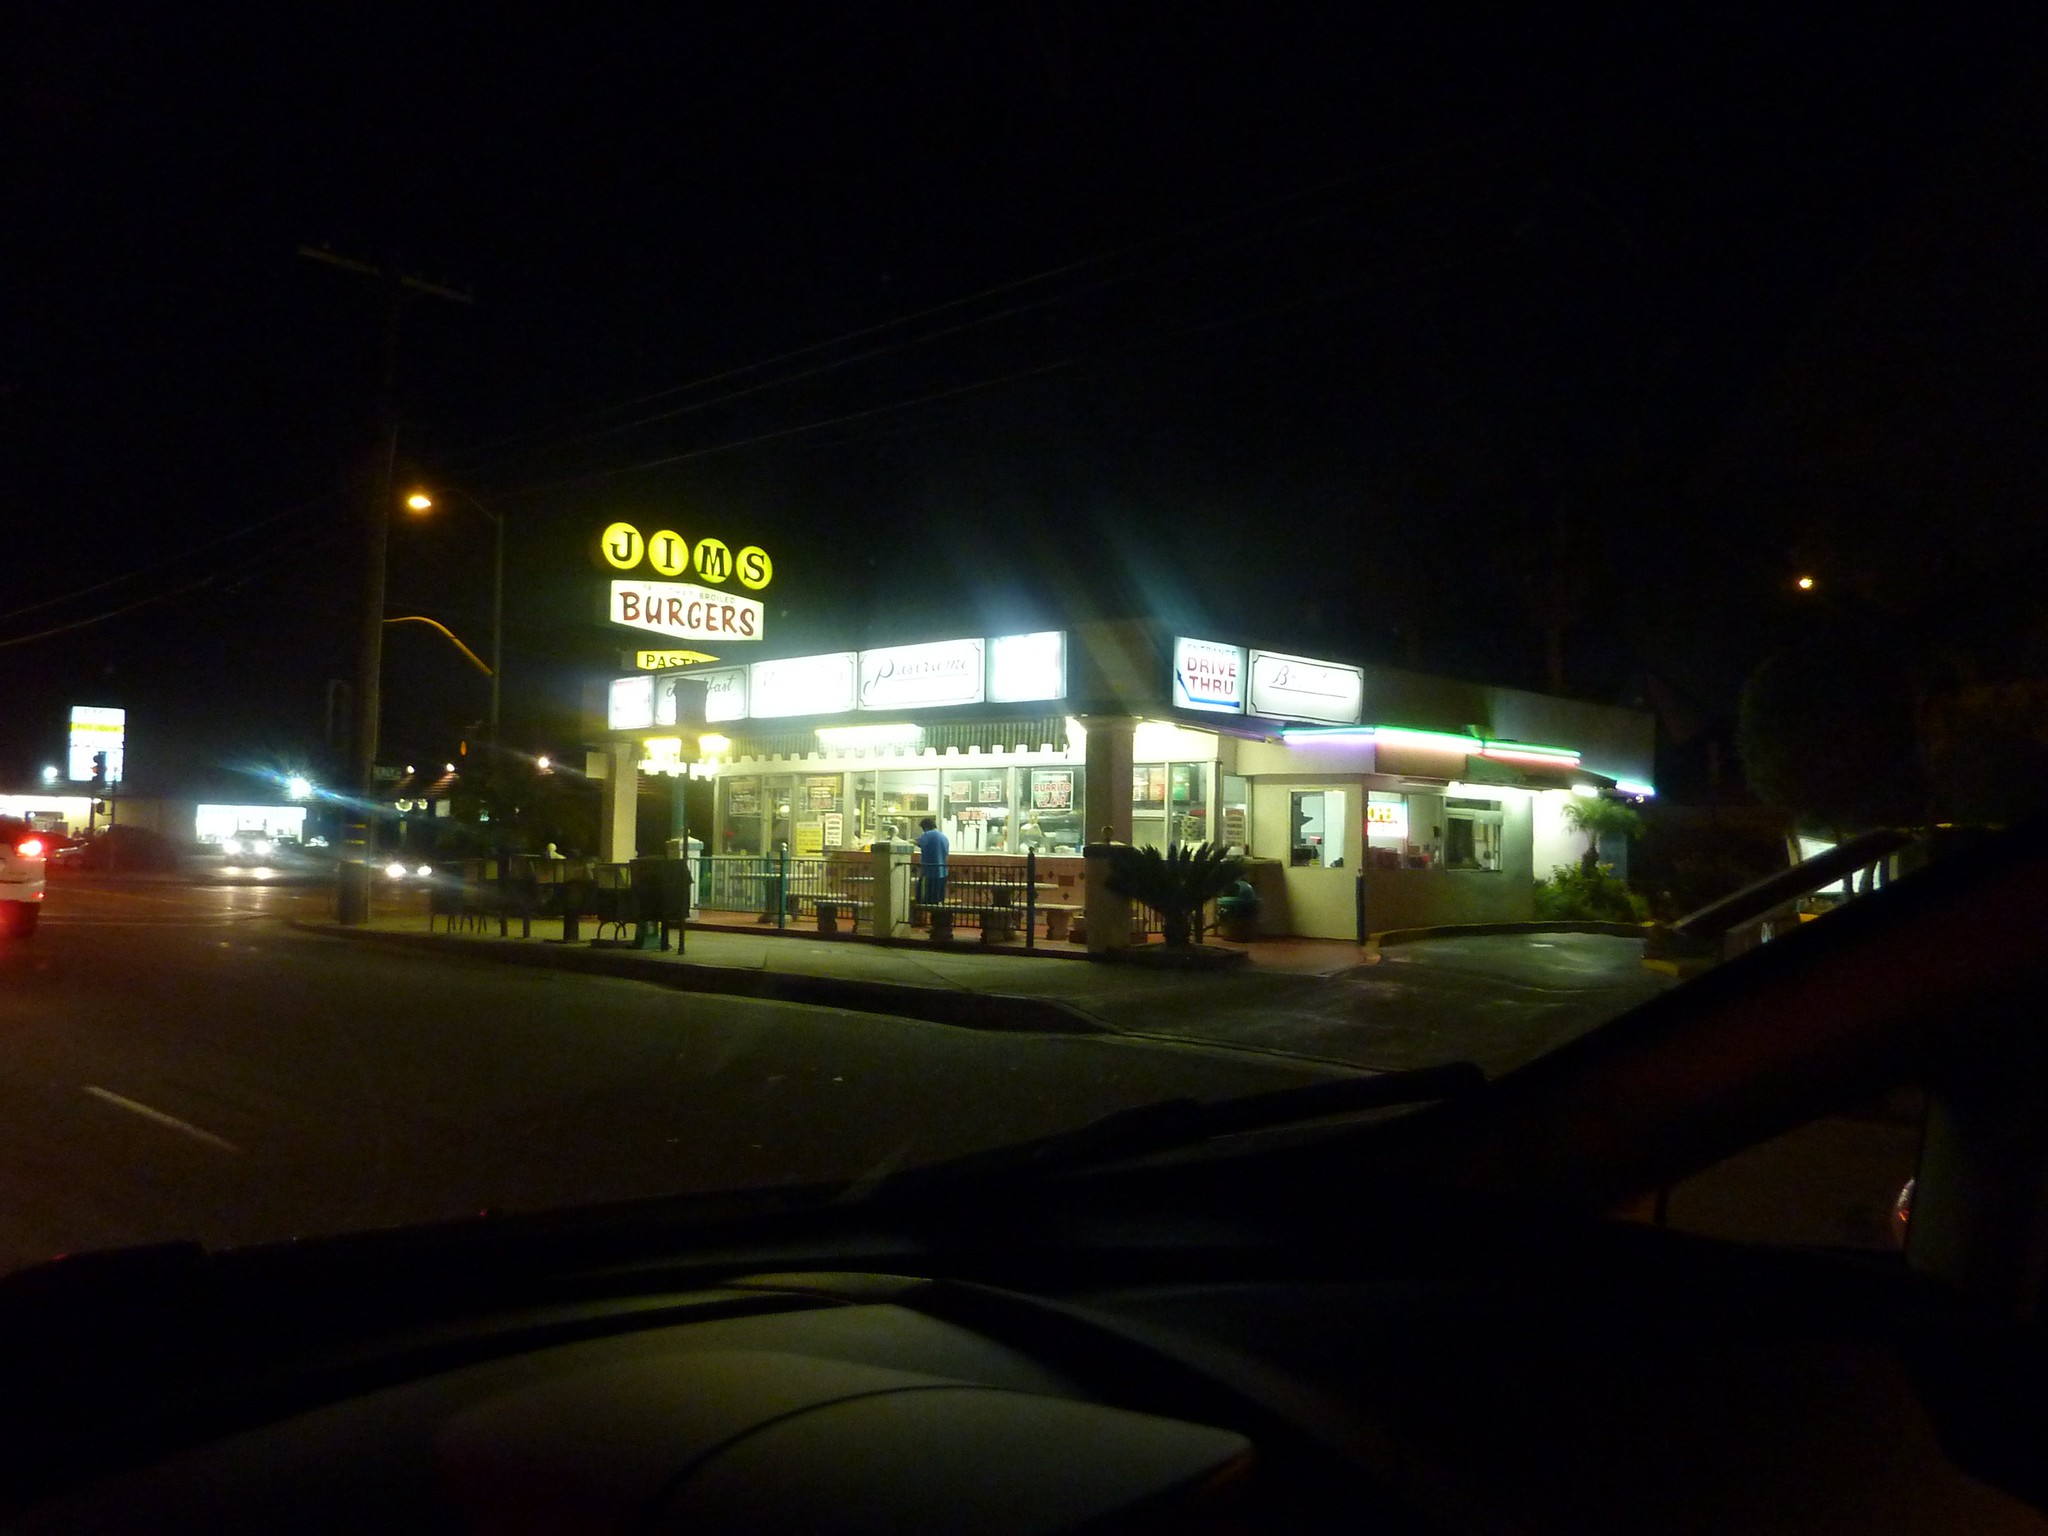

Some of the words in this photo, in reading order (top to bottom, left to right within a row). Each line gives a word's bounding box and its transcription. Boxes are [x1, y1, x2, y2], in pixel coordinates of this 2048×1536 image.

[610, 531, 765, 582] JIMS
[618, 591, 755, 636] BURGERS
[1187, 656, 1237, 677] DRIVE
[1188, 675, 1235, 695] THRU
